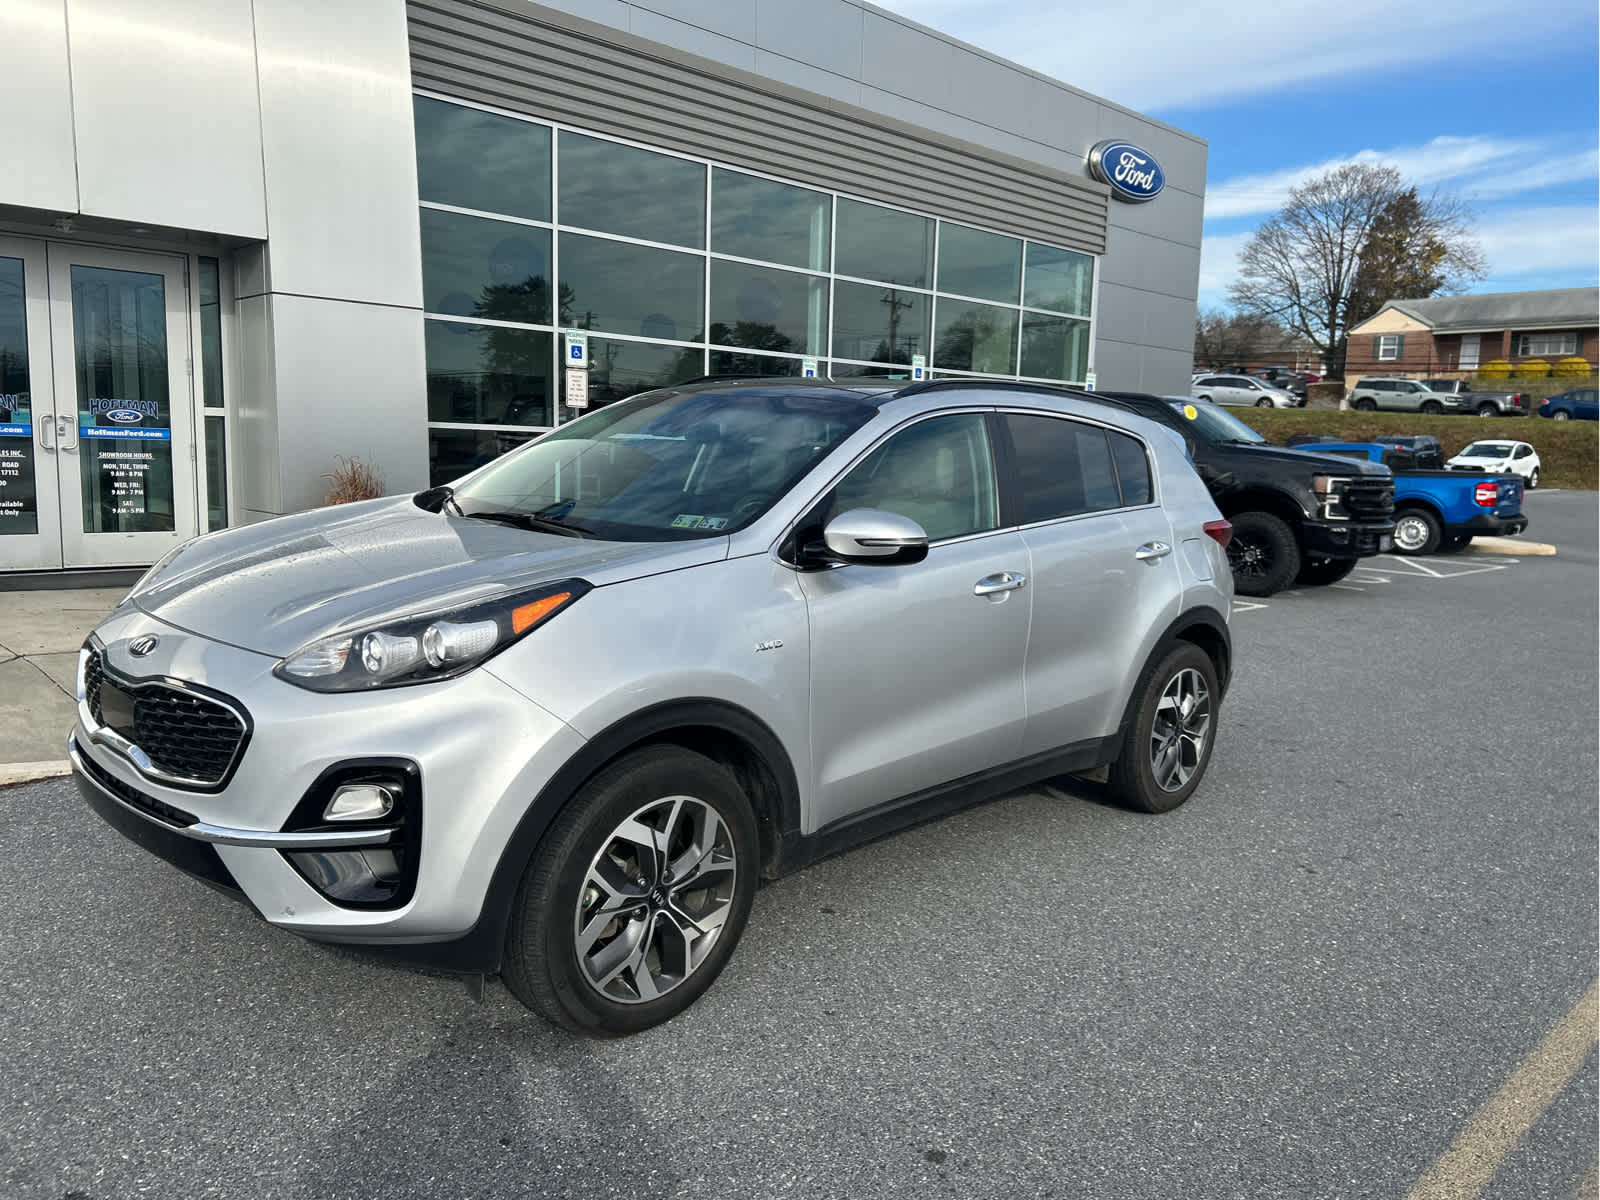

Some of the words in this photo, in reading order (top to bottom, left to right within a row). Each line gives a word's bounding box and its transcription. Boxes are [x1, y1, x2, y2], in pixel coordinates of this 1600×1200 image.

[1115, 152, 1155, 190] Ford
[89, 398, 159, 420] HOFFMAN
[114, 411, 135, 420] Ford
[88, 429, 163, 437] HoffmanFord.com
[754, 640, 784, 652] AWD
